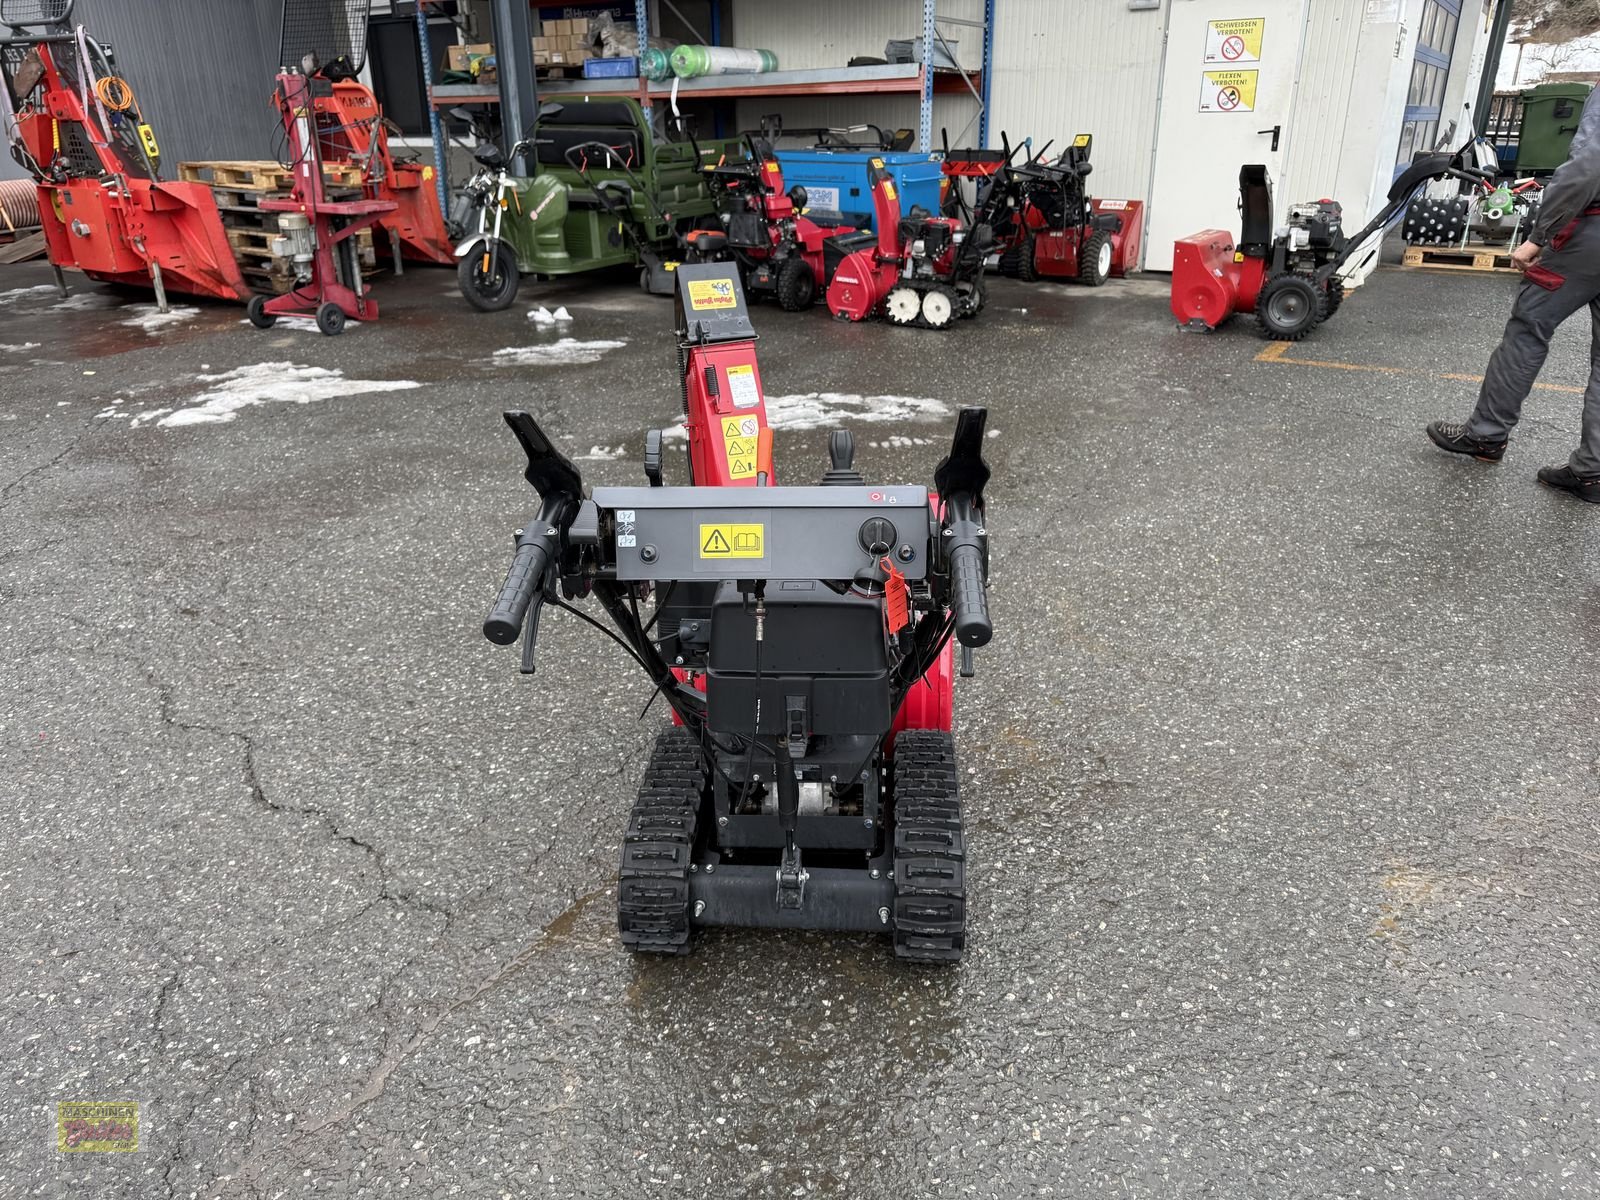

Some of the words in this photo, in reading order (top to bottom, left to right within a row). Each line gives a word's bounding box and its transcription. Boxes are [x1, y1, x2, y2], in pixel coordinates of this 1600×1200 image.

[572, 8, 621, 19] Husqvna
[1215, 21, 1257, 29] SCHWEISSEN
[836, 276, 859, 284] HONDA
